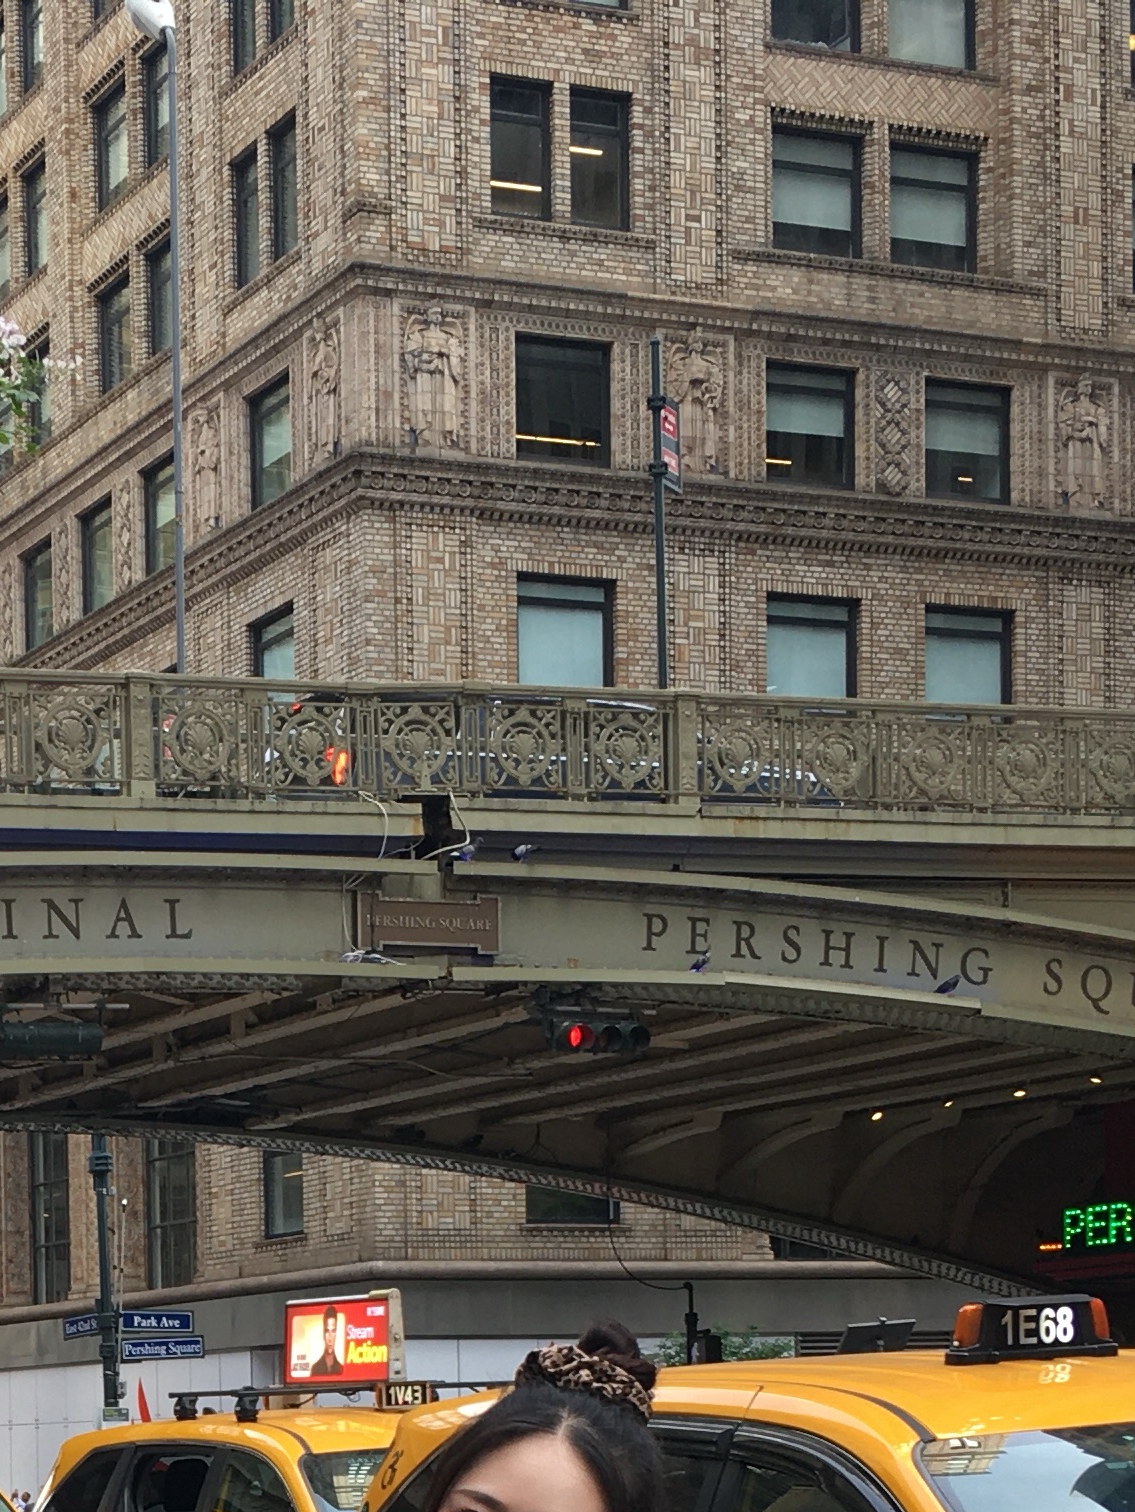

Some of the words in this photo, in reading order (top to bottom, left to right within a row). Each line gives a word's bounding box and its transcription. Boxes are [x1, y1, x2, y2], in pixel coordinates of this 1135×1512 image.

[439, 917, 493, 934] SQUARE
[641, 912, 994, 987] PERSHING
[1042, 957, 1135, 1015] SQ
[1064, 1202, 1135, 1249] PER
[133, 1315, 159, 1328] Park
[160, 1316, 181, 1328] Ave
[1000, 1305, 1074, 1346] 1E68
[346, 1325, 375, 1340] Stream
[124, 1342, 167, 1357] Pershing
[168, 1342, 201, 1357] Square
[346, 1340, 388, 1364] Action
[388, 1385, 423, 1405] 1V43
